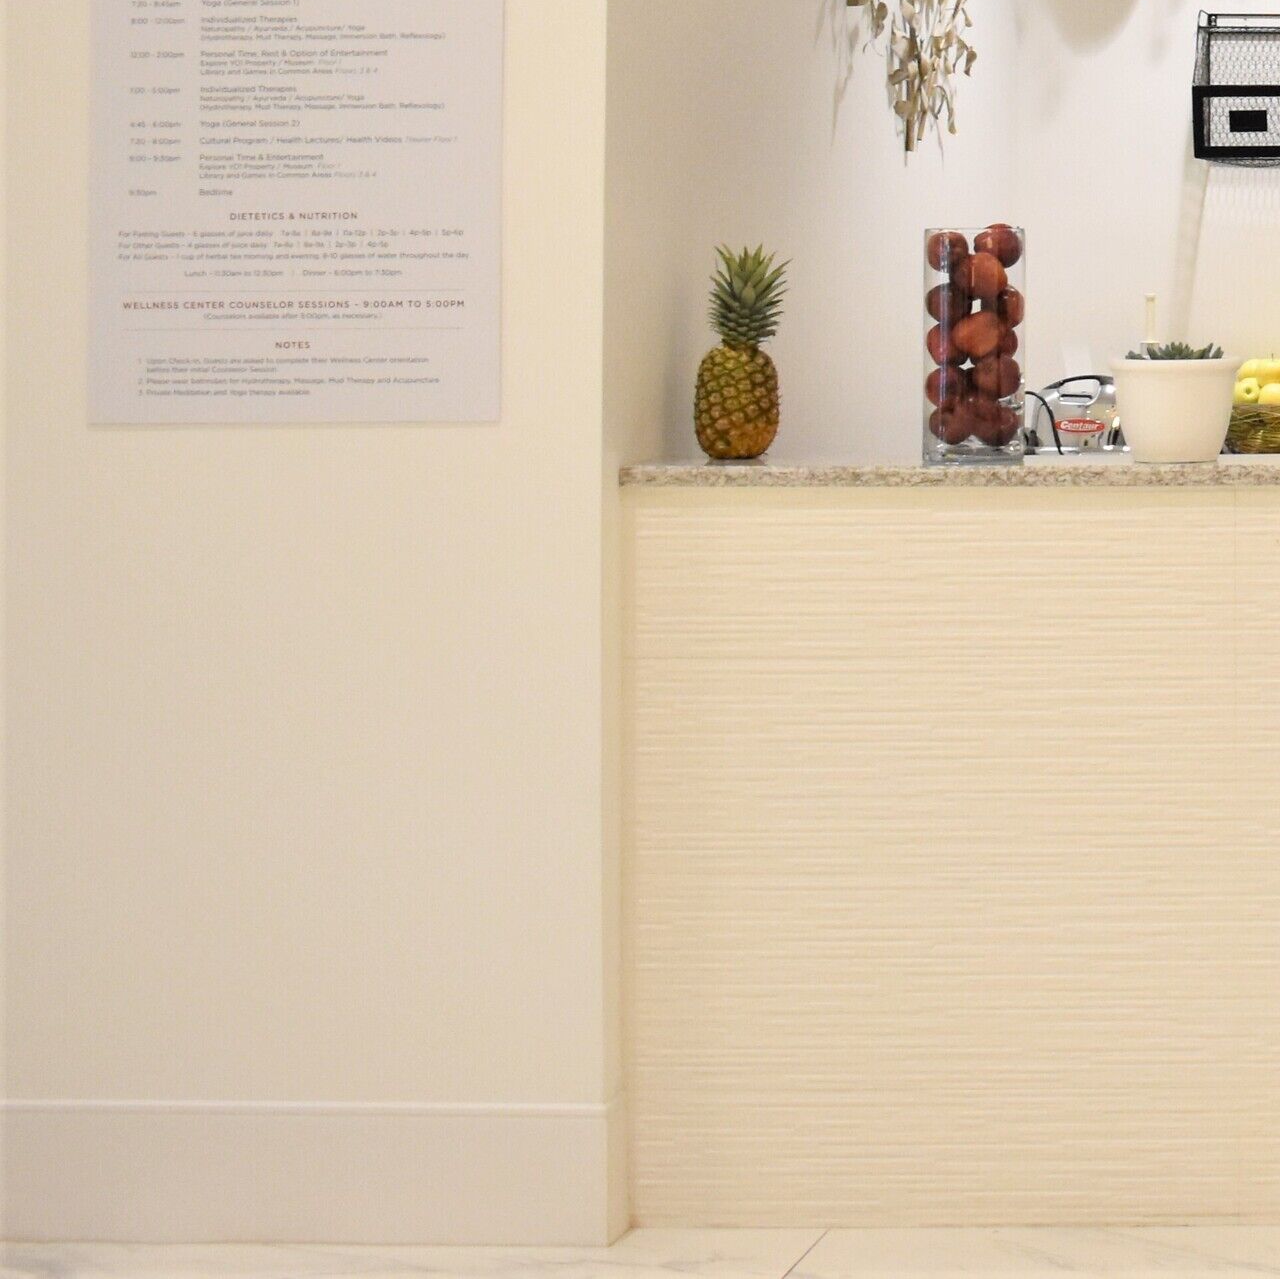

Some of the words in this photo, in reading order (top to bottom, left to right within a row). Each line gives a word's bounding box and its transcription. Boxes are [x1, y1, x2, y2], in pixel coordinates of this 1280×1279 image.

[230, 212, 285, 220] DIETETICS
[299, 212, 358, 220] NUTRITION
[122, 301, 179, 310] WELLNESS
[183, 301, 225, 310] CENTER
[229, 300, 294, 309] COUNSELOR
[298, 300, 350, 309] SESSIONS
[275, 341, 310, 349] NOTES
